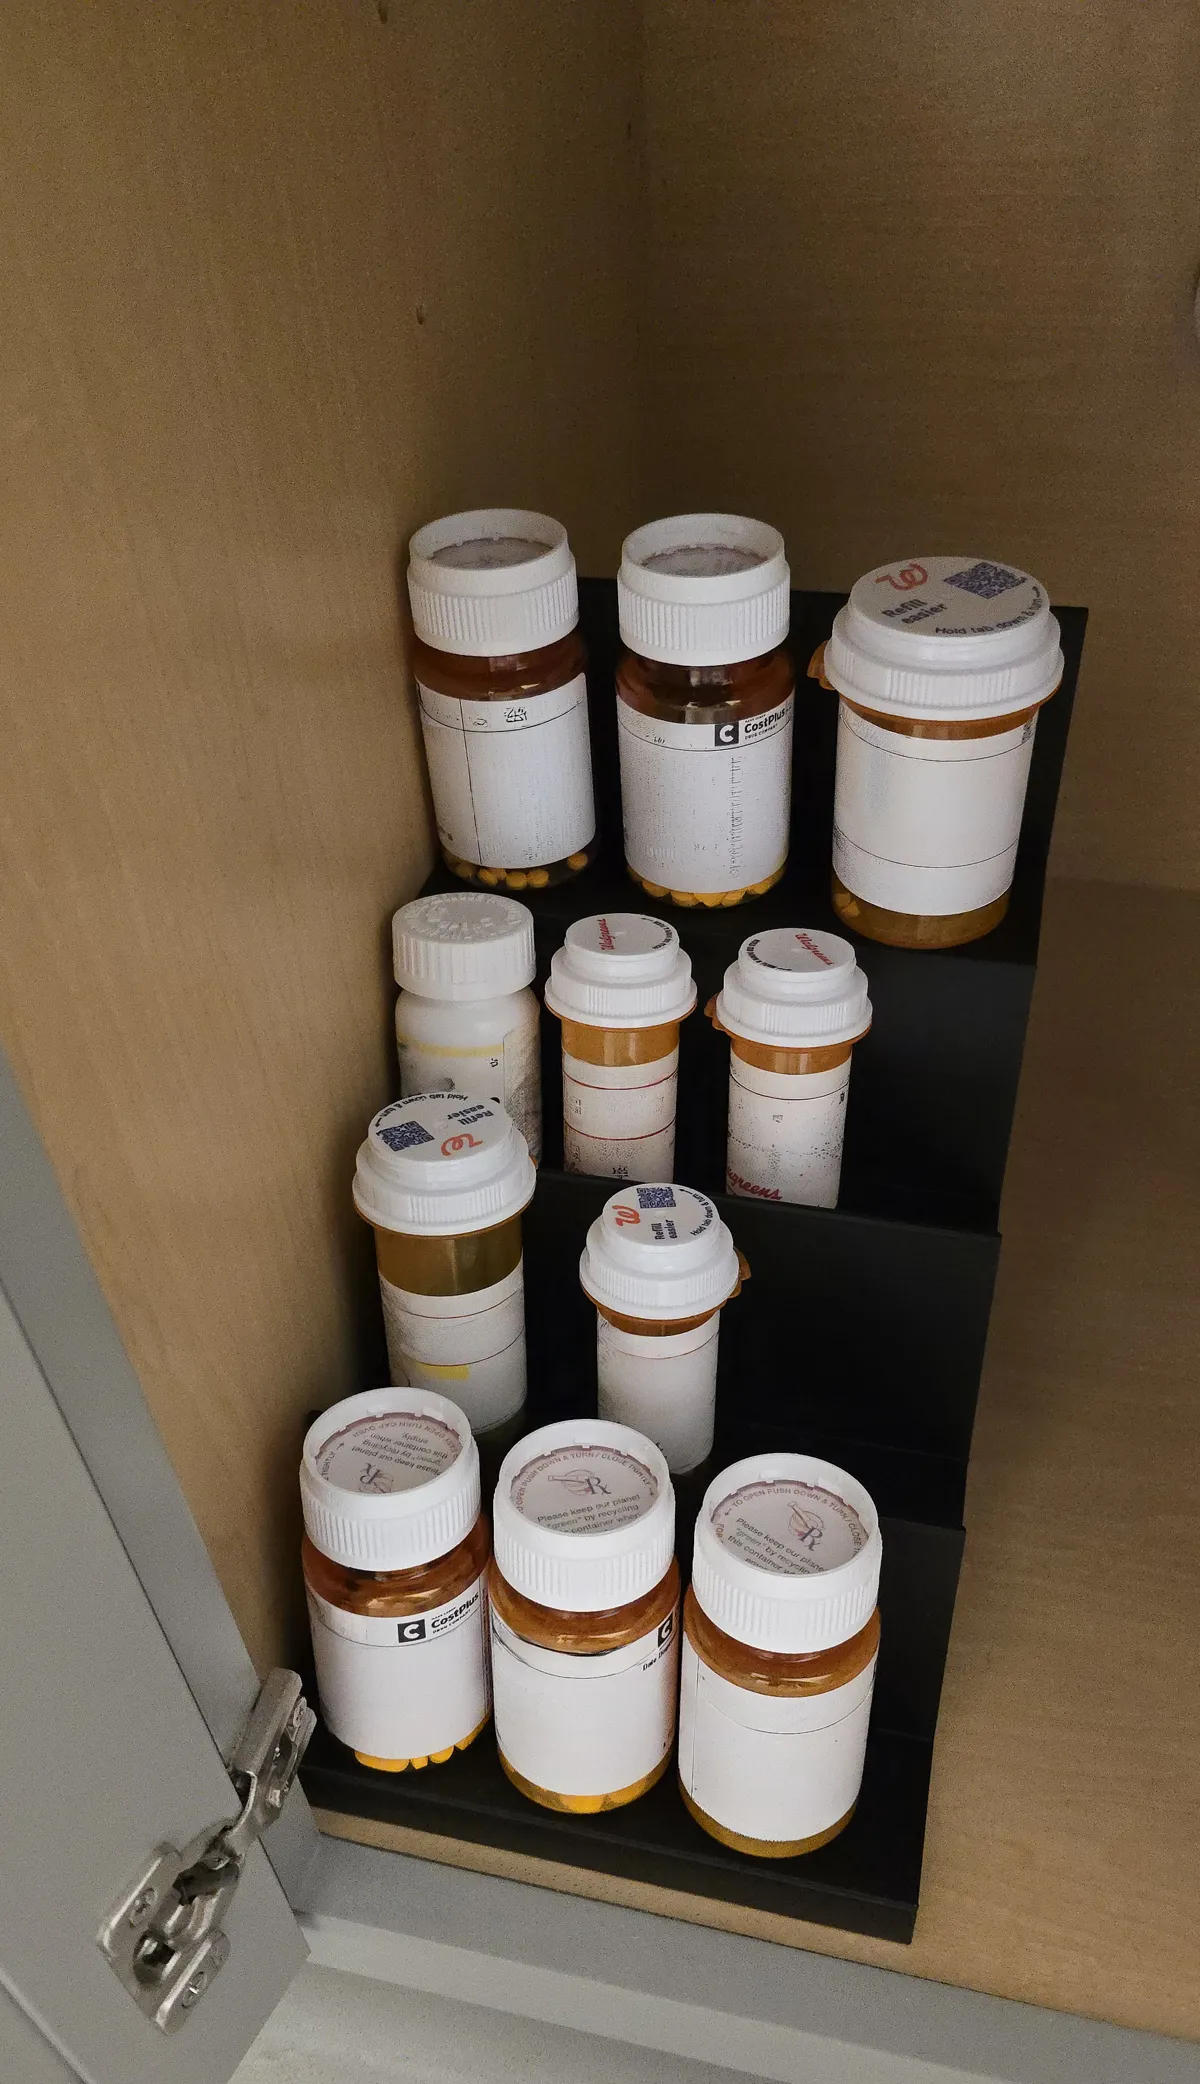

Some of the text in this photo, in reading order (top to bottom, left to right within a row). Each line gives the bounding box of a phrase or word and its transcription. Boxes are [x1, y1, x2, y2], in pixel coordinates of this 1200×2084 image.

[882, 598, 929, 618] Refill
[901, 603, 949, 625] easier
[935, 626, 967, 635] Hold
[971, 626, 994, 634] tab
[447, 1093, 468, 1101] Hold
[447, 1104, 485, 1121] easier
[457, 1109, 494, 1126] Refill
[651, 1223, 666, 1240] Refill
[664, 1219, 678, 1239] easier
[690, 1225, 707, 1236] Hold
[370, 1433, 392, 1443] when
[351, 1445, 379, 1457] planet
[362, 1440, 400, 1455] recycling
[393, 1440, 432, 1454] container
[433, 1450, 449, 1460] this
[394, 1459, 416, 1469] keep
[536, 1493, 642, 1523] Please keep our planet
[731, 1498, 744, 1509] TO
[743, 1490, 766, 1502] OPEN
[767, 1487, 792, 1495] PUSH
[793, 1488, 821, 1502] DOWN
[828, 1501, 849, 1520] TURN
[583, 1514, 596, 1523] by
[597, 1503, 640, 1519] recycling
[571, 1519, 615, 1534] container
[727, 1535, 743, 1548] this
[743, 1545, 784, 1571] container
[736, 1517, 826, 1572] Please keep our plane
[765, 1546, 778, 1557] by
[777, 1554, 811, 1574] recyclin
